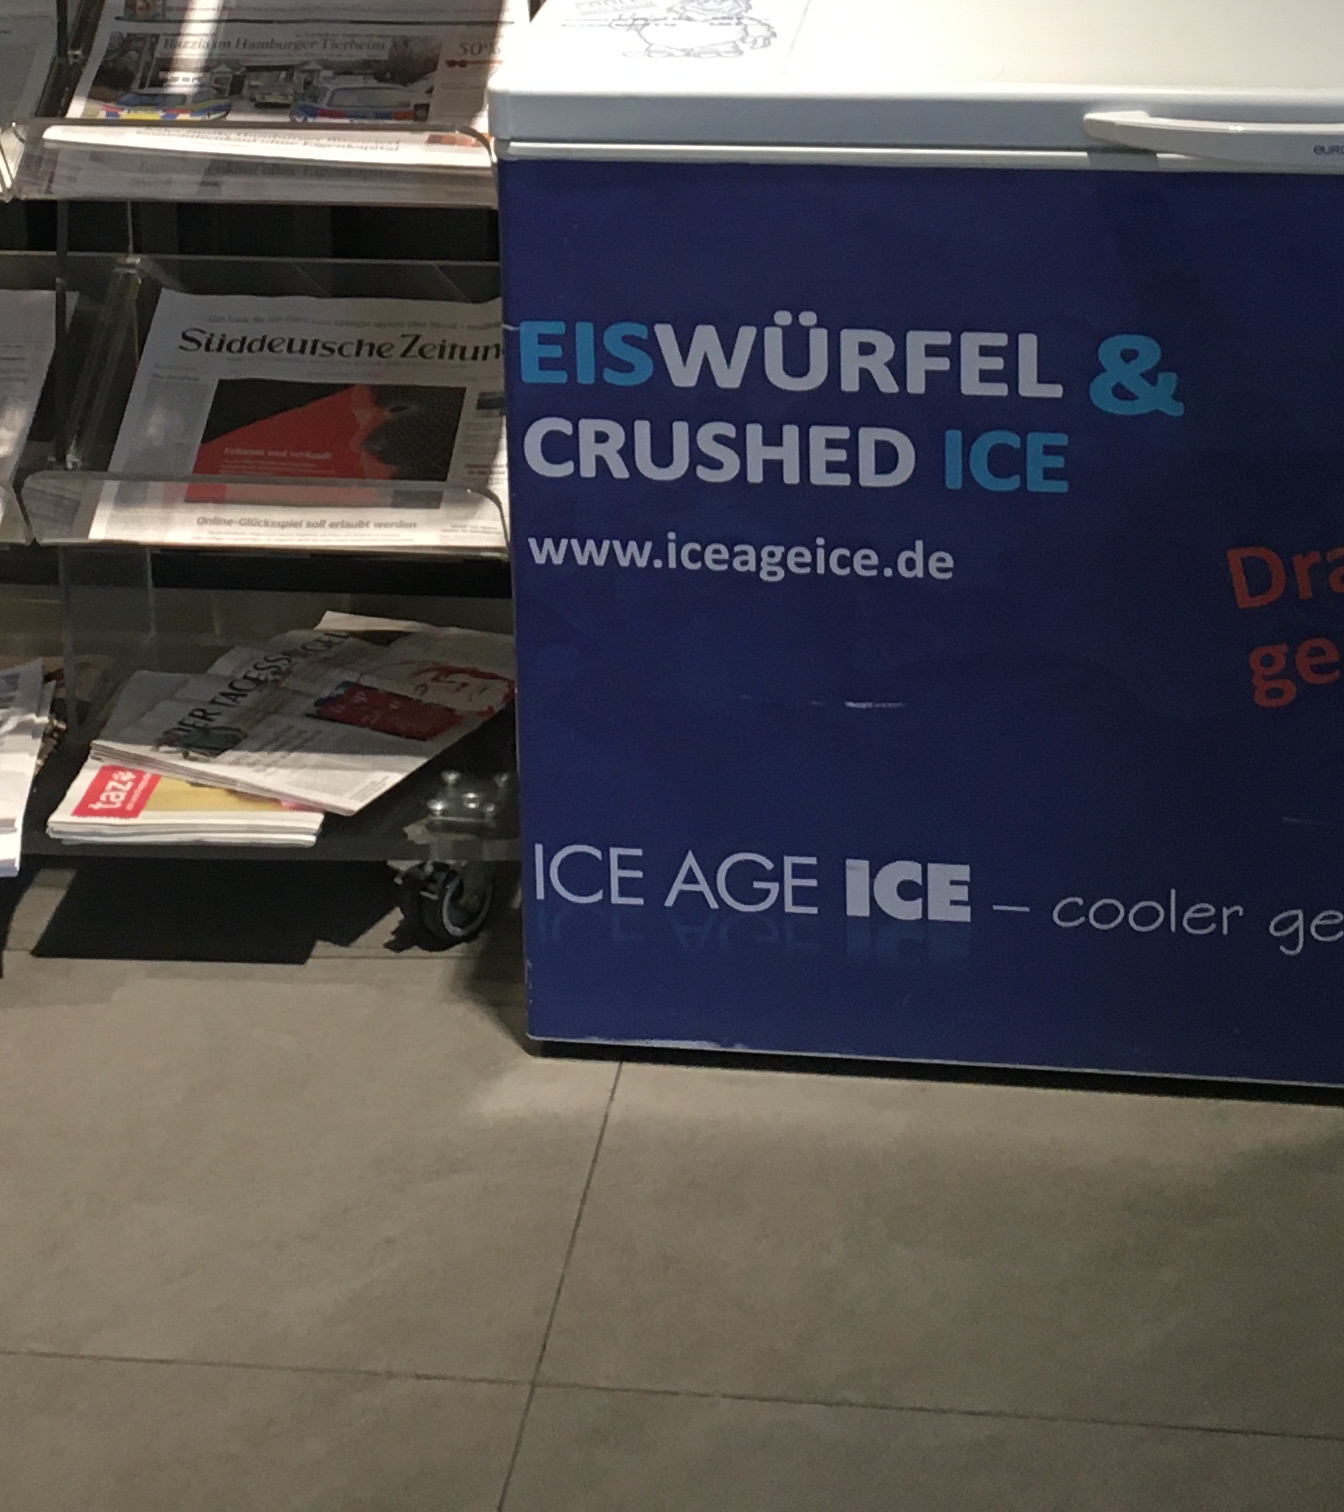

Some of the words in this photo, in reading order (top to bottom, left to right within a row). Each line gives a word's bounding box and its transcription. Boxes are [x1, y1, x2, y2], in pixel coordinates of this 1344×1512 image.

[235, 38, 316, 52] Hamburger
[179, 328, 396, 359] Süddeutsche
[400, 334, 502, 361] Zeitun
[518, 310, 1064, 399] EISWÜRFEL
[1088, 333, 1185, 417] &
[523, 416, 916, 488] CRUSHED
[944, 429, 1070, 494] ICE
[196, 516, 303, 529] Online-Glücksspiel
[328, 519, 372, 529] erlaubt
[374, 520, 417, 529] werden
[527, 531, 955, 582] www.iceageice.de
[88, 780, 134, 810] taz
[534, 842, 645, 906] ICE
[664, 849, 819, 915] AGE
[845, 858, 971, 923] ICE
[1052, 889, 1243, 936] cooler
